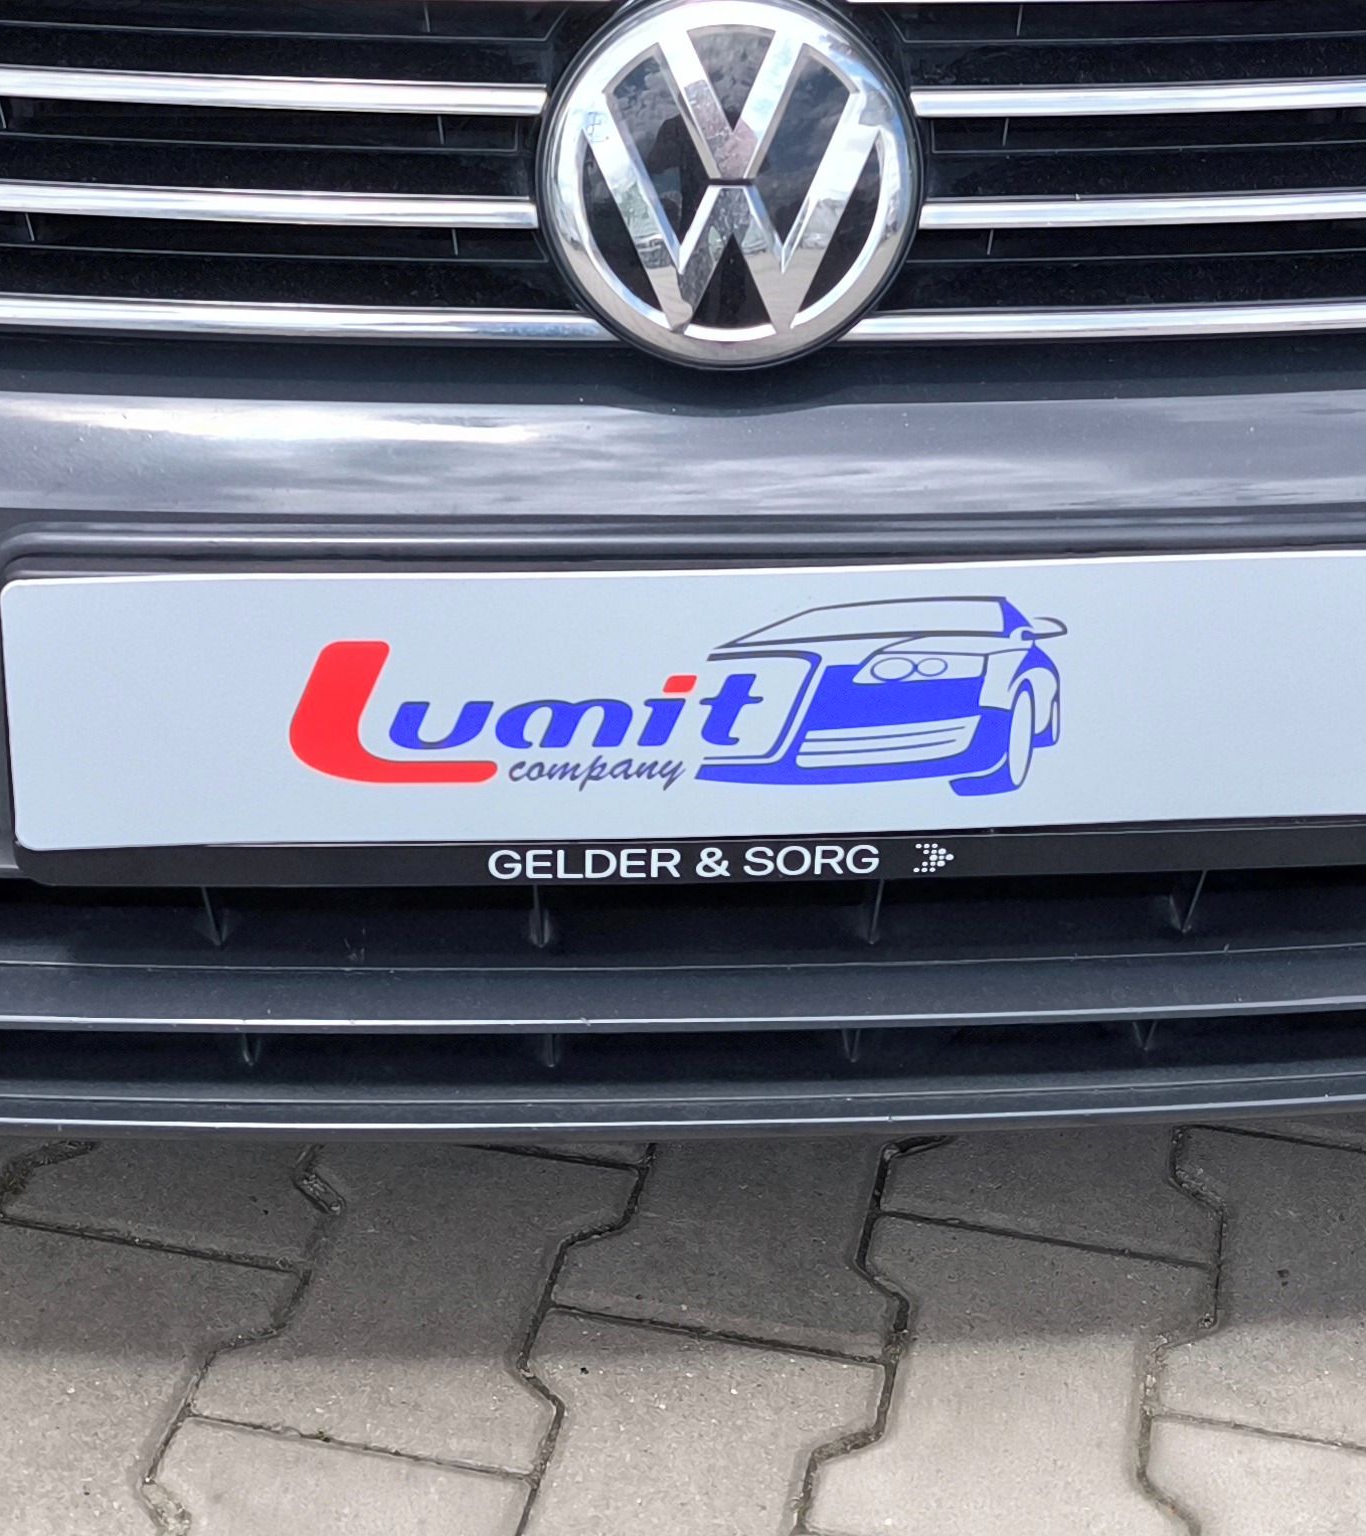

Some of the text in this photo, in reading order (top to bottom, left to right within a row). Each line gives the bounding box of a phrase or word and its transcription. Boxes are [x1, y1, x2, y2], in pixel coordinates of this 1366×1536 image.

[289, 640, 763, 784] Lumit
[507, 754, 687, 791] company
[487, 844, 881, 880] GELDER & SORG
